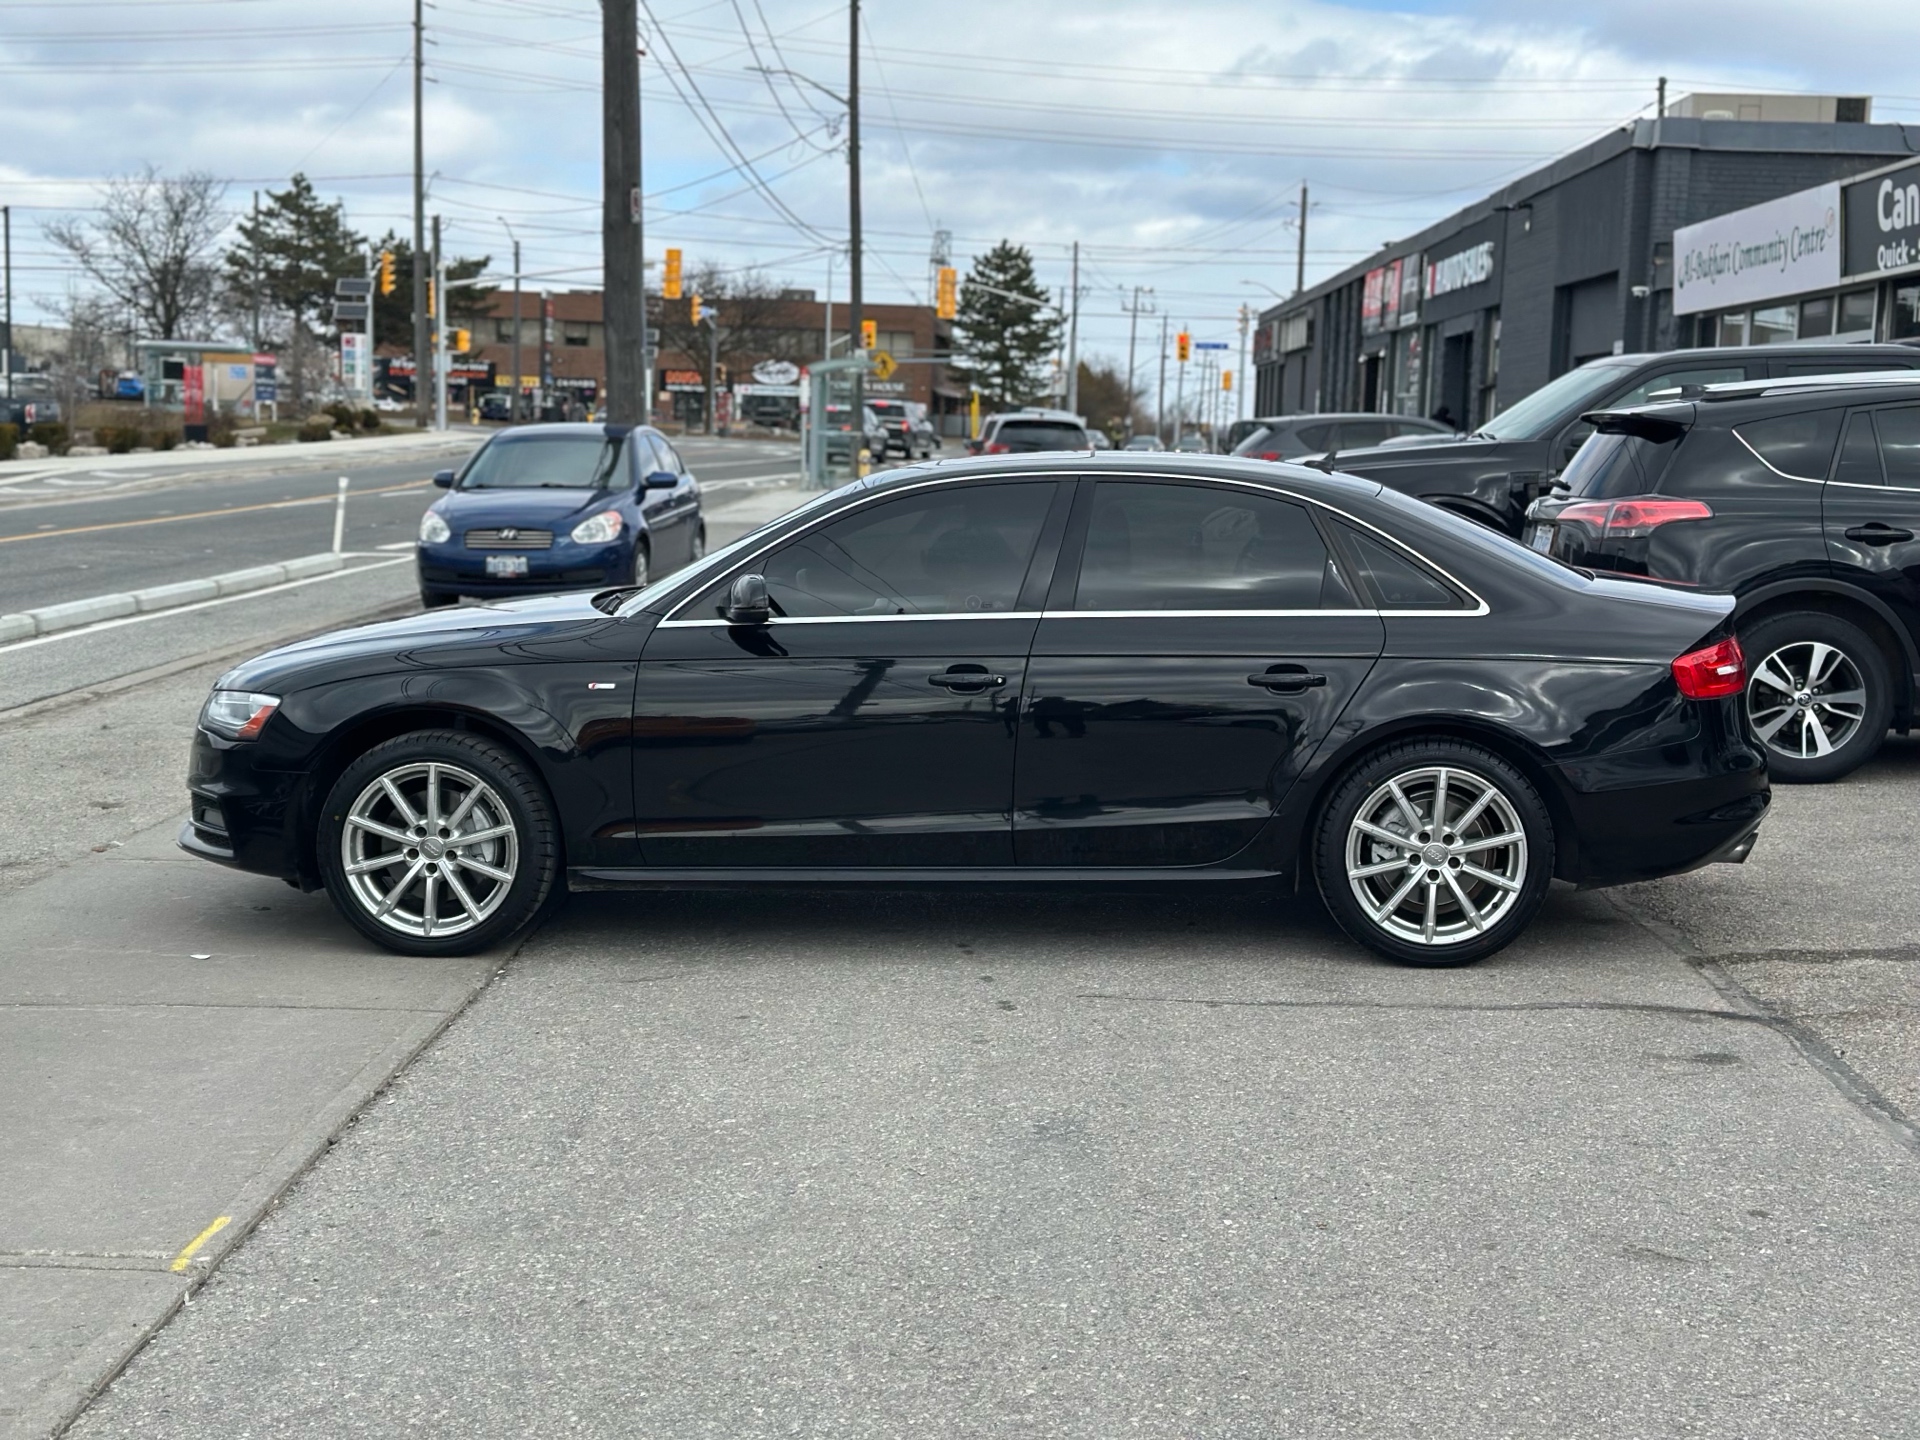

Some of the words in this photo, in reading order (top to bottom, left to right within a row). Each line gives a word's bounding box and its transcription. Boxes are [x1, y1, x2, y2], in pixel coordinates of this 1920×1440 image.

[1877, 178, 1920, 232] Can
[1732, 229, 1789, 275] Community
[1790, 225, 1826, 262] Centre
[1877, 238, 1909, 271] Quick
